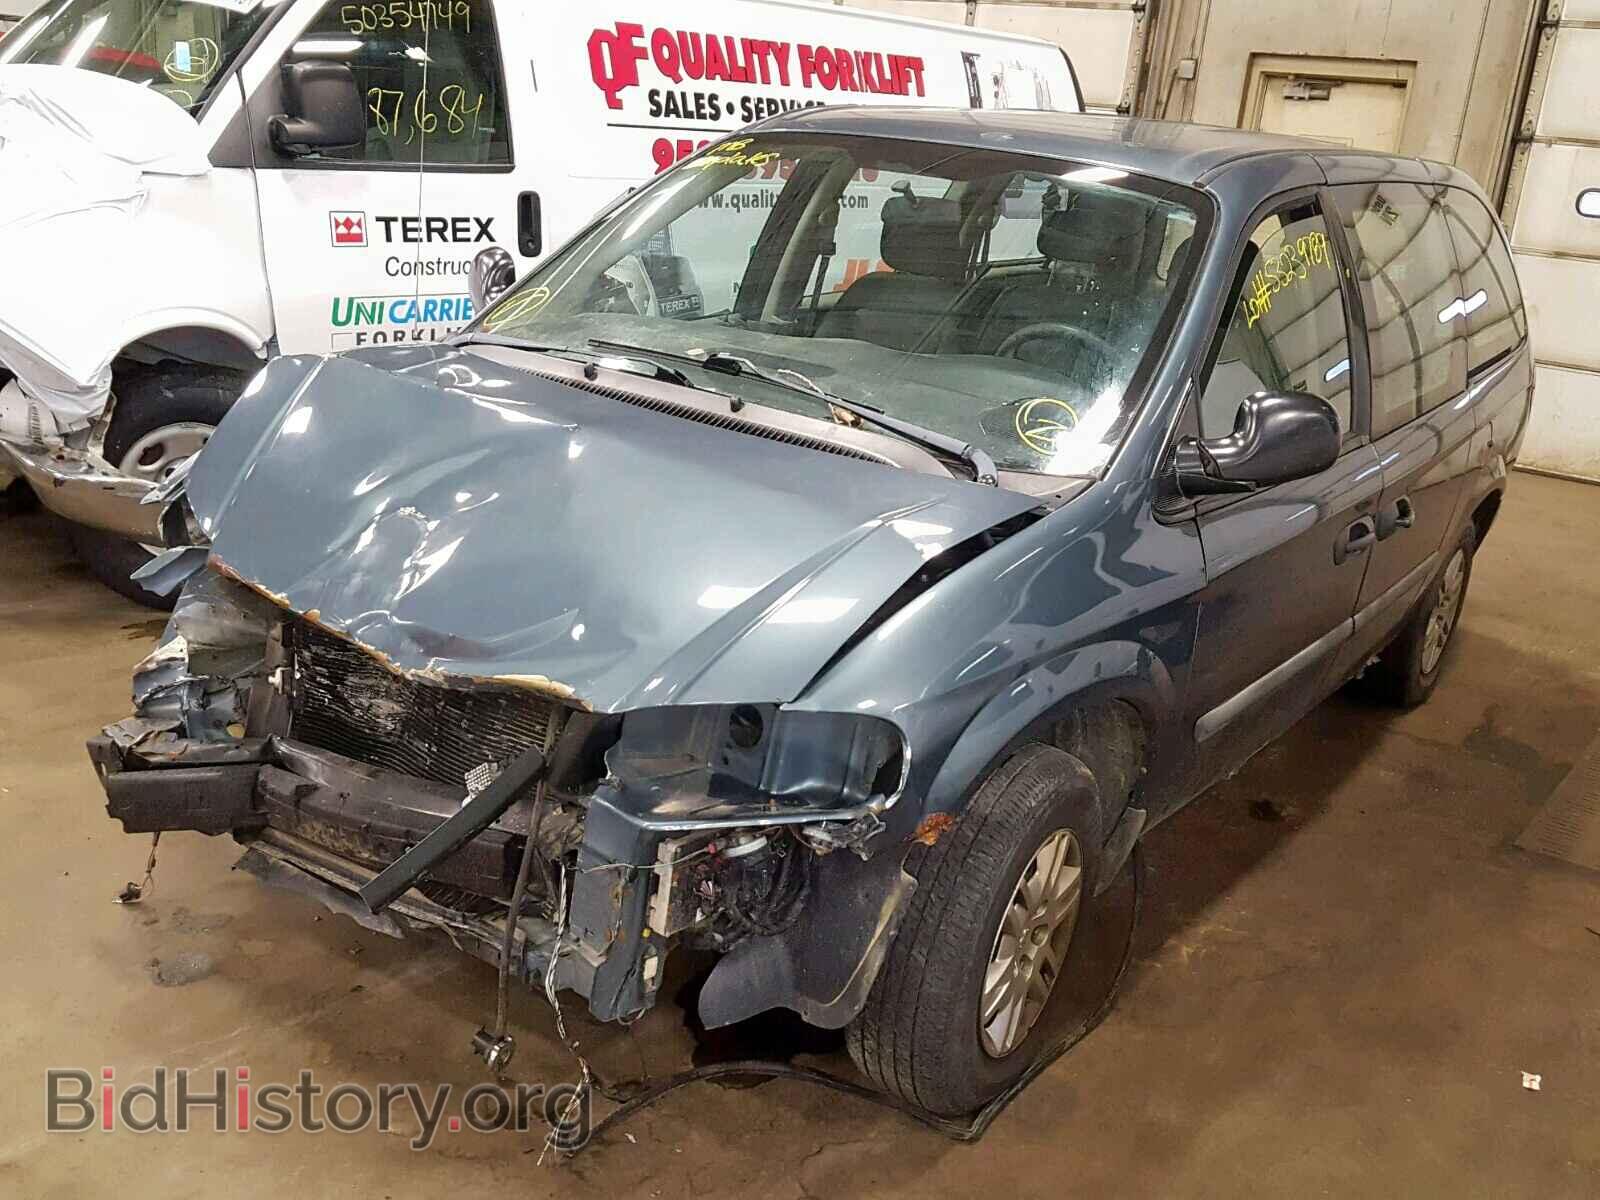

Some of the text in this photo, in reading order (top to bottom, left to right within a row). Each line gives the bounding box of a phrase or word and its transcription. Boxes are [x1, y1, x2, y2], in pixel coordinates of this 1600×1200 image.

[651, 27, 925, 97] QUALITY FORKLIFT
[648, 88, 721, 121] SALES
[375, 216, 497, 243] TEREX
